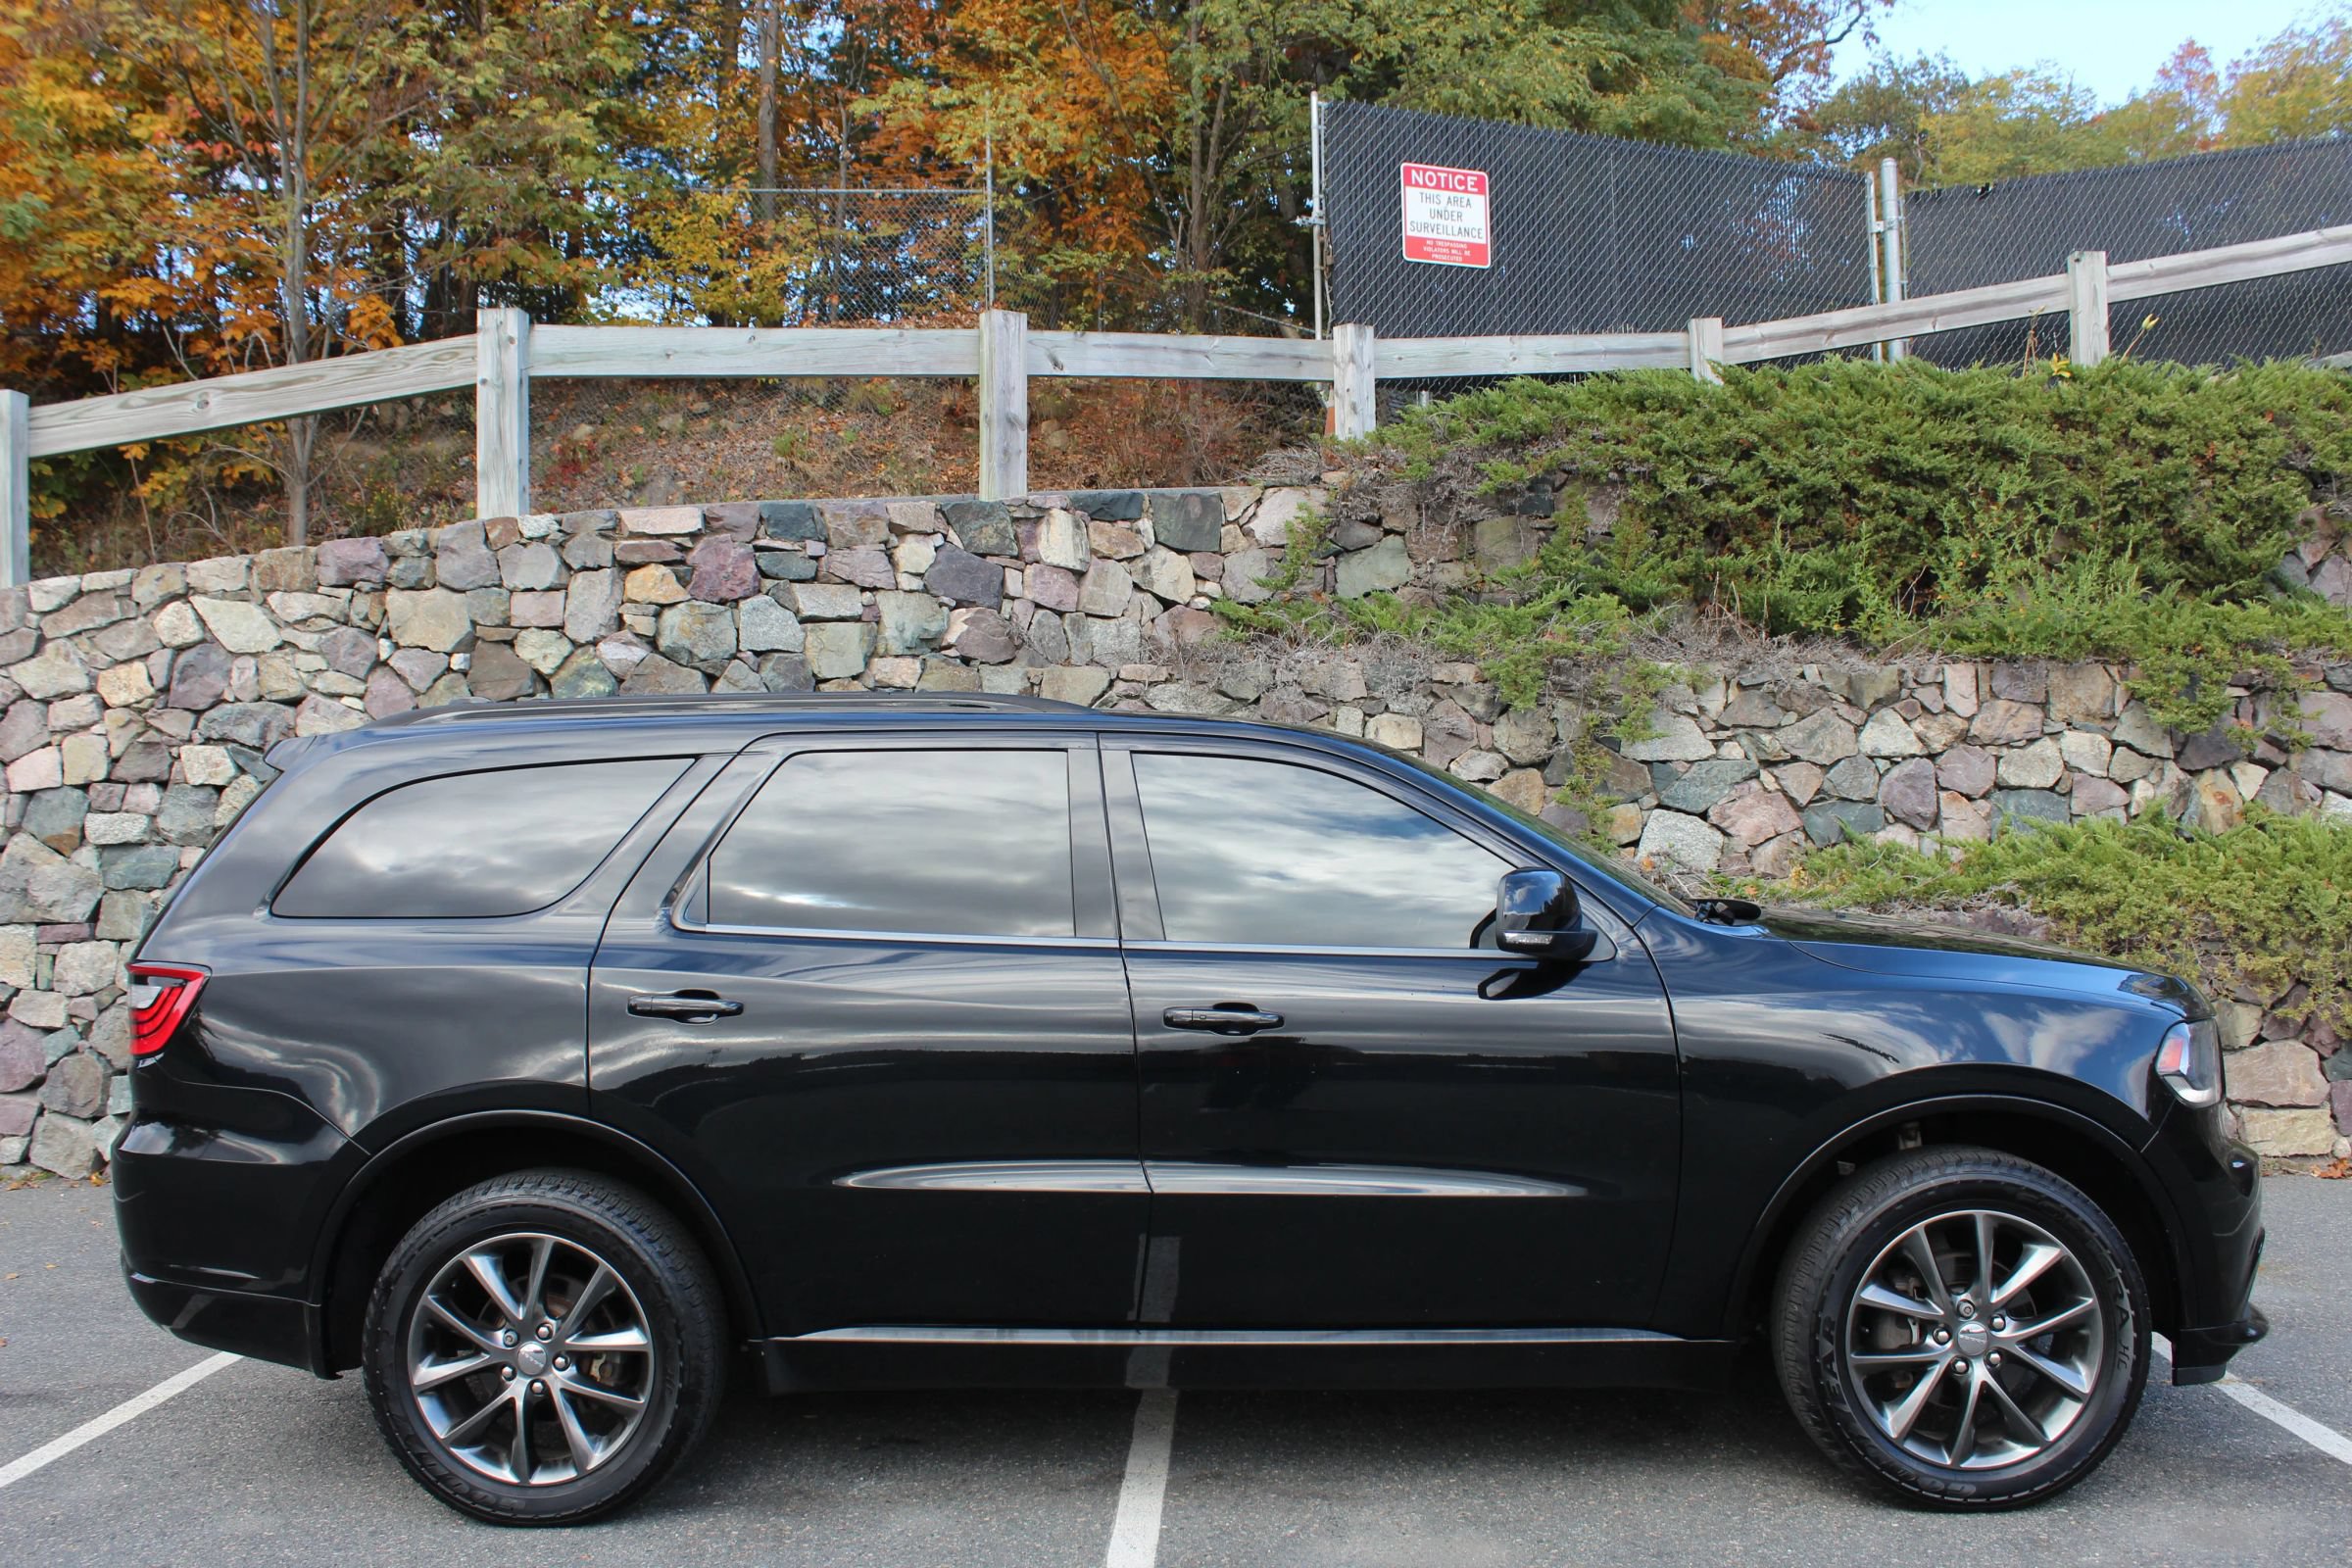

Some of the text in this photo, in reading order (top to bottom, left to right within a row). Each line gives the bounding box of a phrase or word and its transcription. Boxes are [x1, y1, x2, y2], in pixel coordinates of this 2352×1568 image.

[1411, 169, 1479, 192] NOTICE
[1419, 192, 1472, 209] THIS AREA
[1429, 208, 1463, 221] UNDER
[1409, 220, 1483, 239] SURVEILLANCE
[1435, 240, 1468, 249] TRESPASSING
